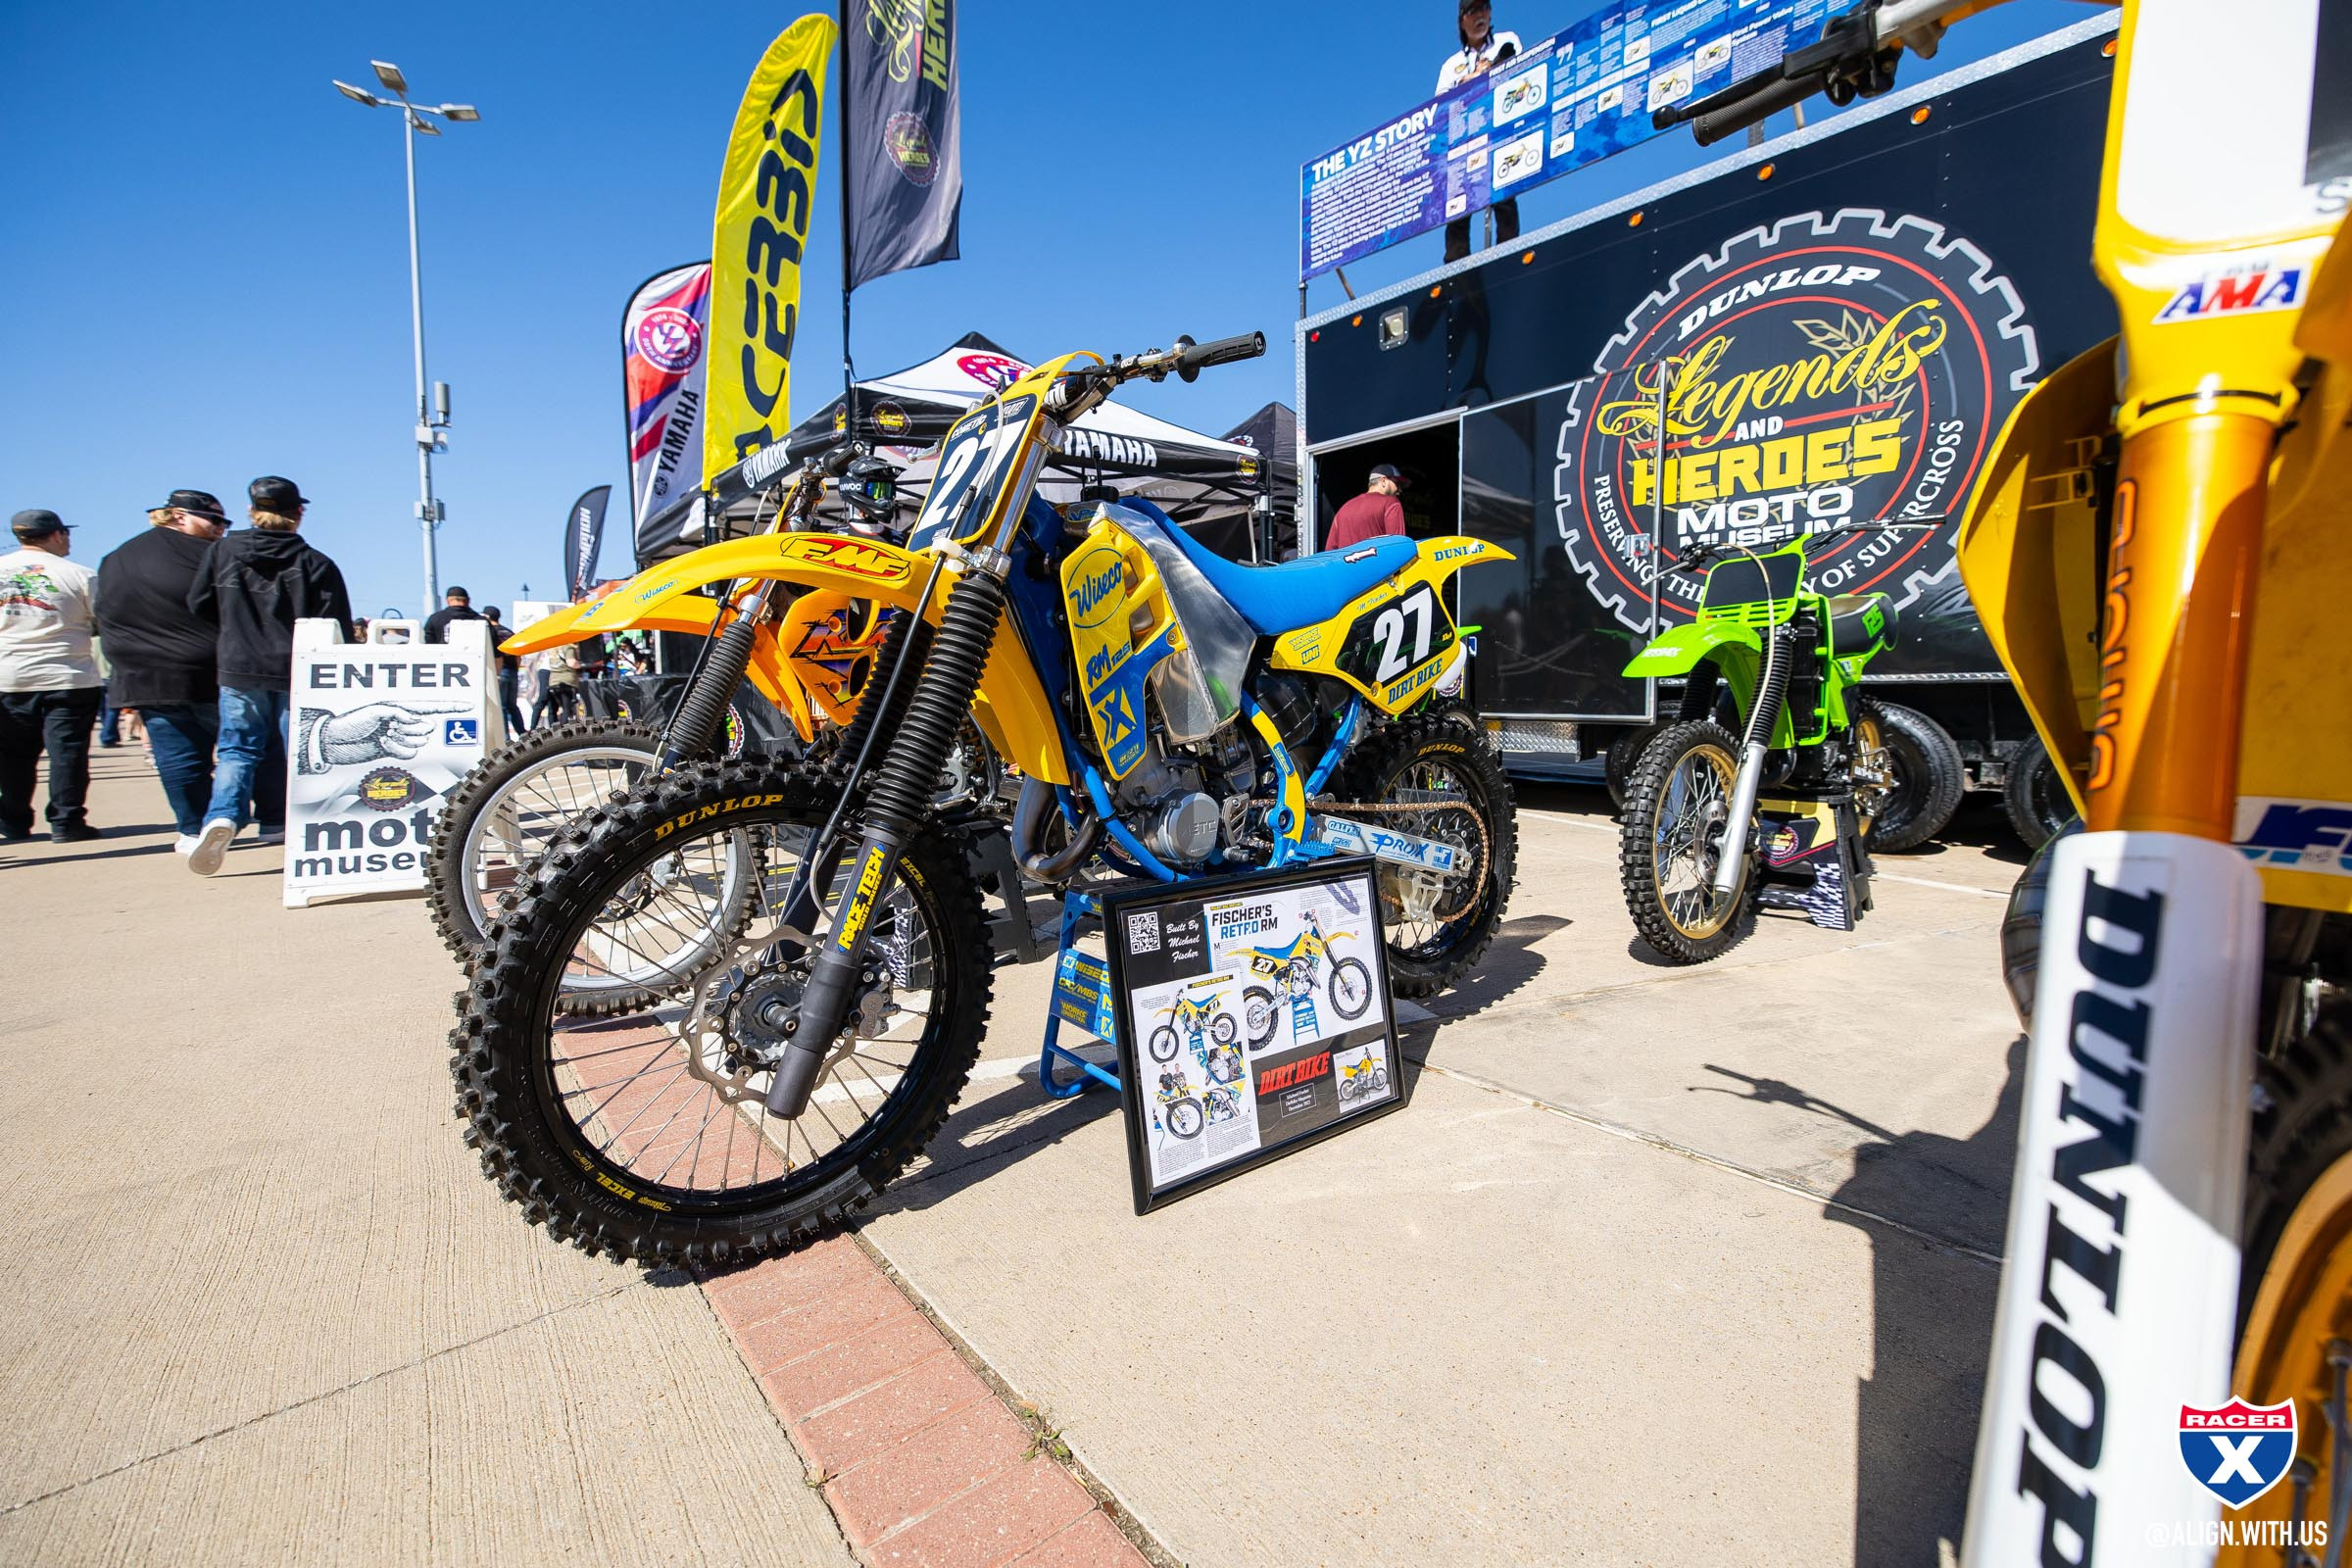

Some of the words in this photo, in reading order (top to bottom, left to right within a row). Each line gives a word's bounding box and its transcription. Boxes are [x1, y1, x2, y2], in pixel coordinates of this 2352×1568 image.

[1311, 152, 1346, 181] THE
[1348, 136, 1372, 164] YZ
[1375, 103, 1438, 150] STORY
[1678, 264, 1882, 341] DUNLOP
[2162, 270, 2300, 318] AMA
[1596, 299, 1946, 448] Legends
[659, 390, 700, 473] YAMAHA
[1063, 429, 1157, 467] YAMAHA
[1734, 416, 1784, 442] AND
[914, 419, 1027, 534] 27
[1632, 418, 1902, 507] HEROES
[1677, 486, 1853, 535] MOTO
[1820, 561, 1857, 588] OF
[1860, 419, 1964, 567] SUPRCROSS
[1679, 516, 1852, 549] MUSEUM
[781, 538, 910, 574] FMF
[642, 581, 674, 601] Wiseco
[1069, 562, 1122, 617] Wiseco
[1374, 587, 1433, 683] 27
[311, 663, 470, 688] ENTER
[1086, 643, 1111, 688] RM
[1111, 641, 1131, 666] 125
[1387, 676, 1416, 705] DIRT
[1416, 659, 1443, 687] BIKE
[1417, 743, 1465, 757] DUNLOP
[305, 808, 435, 852] mot
[655, 795, 784, 842] DUNLOP
[295, 851, 429, 877] muse
[900, 857, 926, 887] EXCEL
[838, 897, 866, 950] RACE
[857, 846, 885, 897] TECH
[1212, 905, 1272, 926] FISCHER'S
[1165, 922, 1186, 934] Built
[1188, 919, 1200, 932] By
[1168, 935, 1200, 948] Michael
[1220, 920, 1259, 939] RETRO
[1260, 916, 1278, 931] RM
[1172, 949, 1200, 963] Fischer
[1258, 1062, 1297, 1097] DIRT
[1294, 1051, 1331, 1083] BIKE
[596, 1171, 636, 1200] EXCEL
[2017, 867, 2164, 1568] DUNLOP
